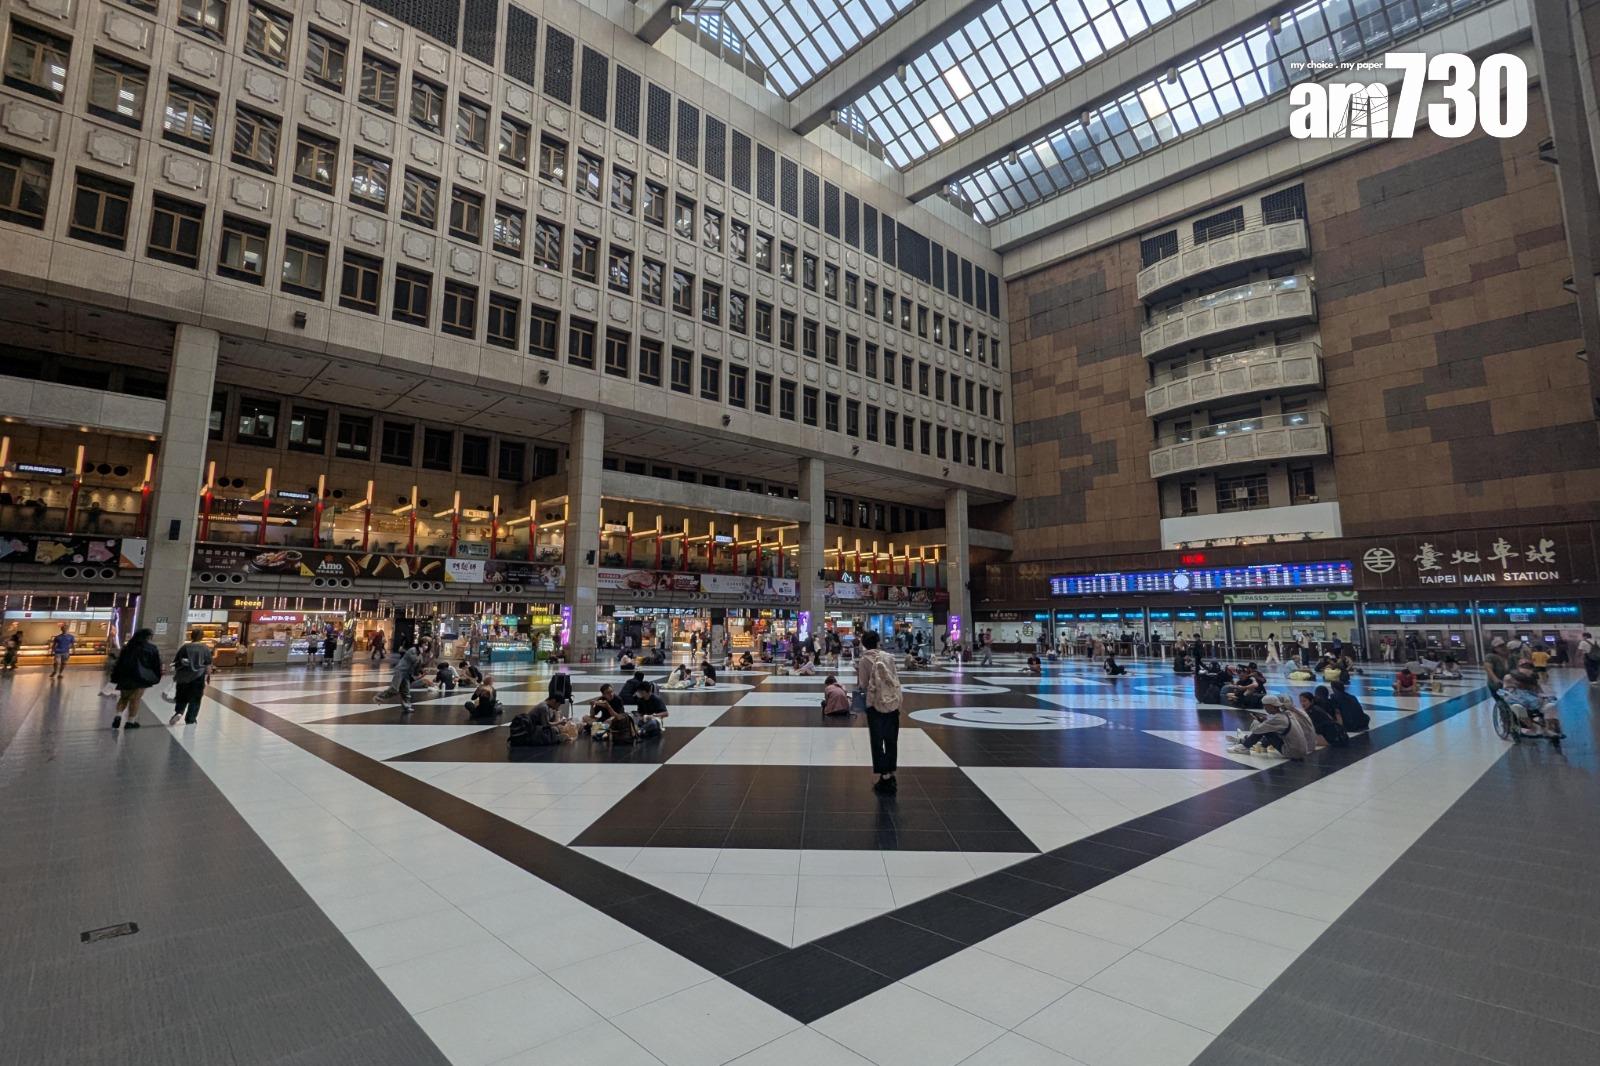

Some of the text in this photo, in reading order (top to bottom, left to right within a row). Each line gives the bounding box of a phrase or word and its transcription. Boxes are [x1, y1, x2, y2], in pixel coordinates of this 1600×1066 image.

[18, 464, 63, 474] STARBUCKS
[1413, 537, 1557, 571] 臺北車站
[318, 560, 342, 570] Amo
[1419, 571, 1559, 584] TAIPEI MAIN STATION
